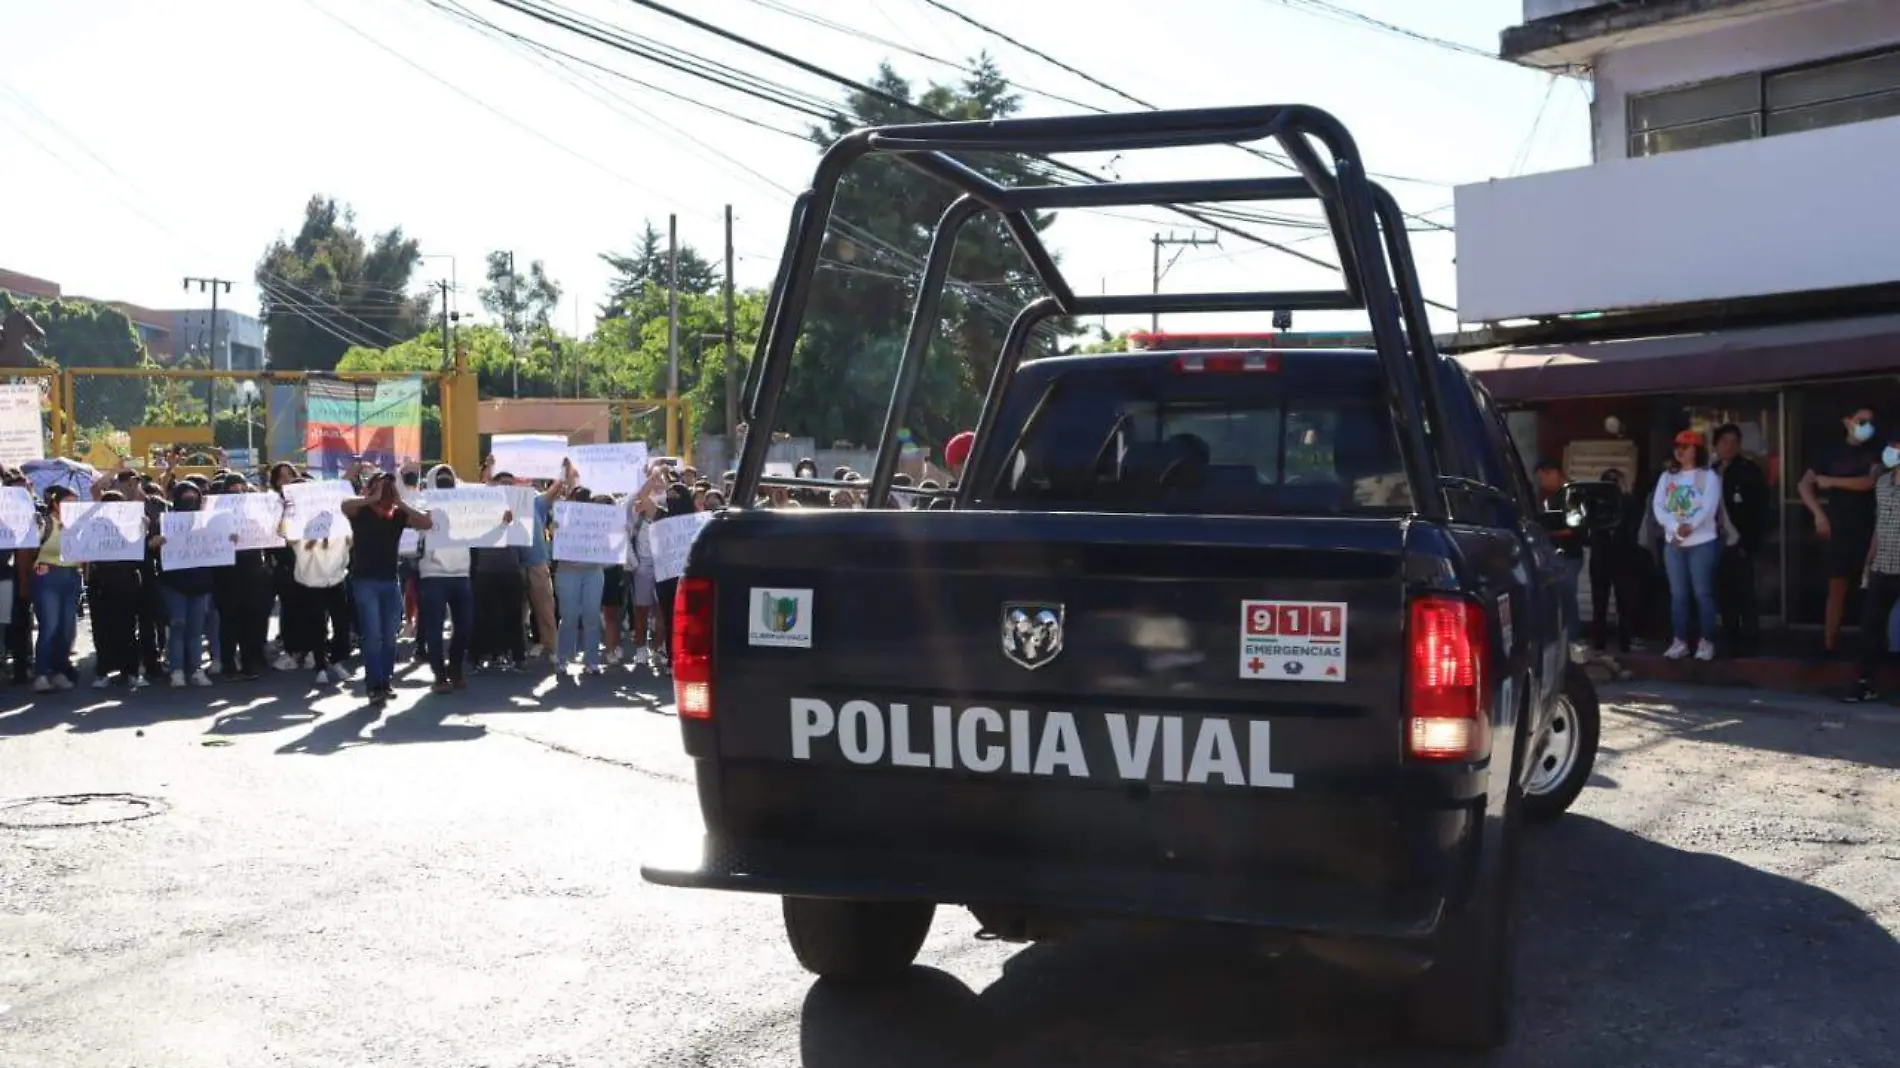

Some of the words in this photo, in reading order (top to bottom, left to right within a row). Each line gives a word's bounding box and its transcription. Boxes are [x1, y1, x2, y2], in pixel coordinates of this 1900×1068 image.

[1253, 609, 1331, 633] 911
[1245, 644, 1341, 657] EMERGENCIAS
[790, 697, 1090, 777] POLICIA
[1105, 712, 1295, 788] VIAL
